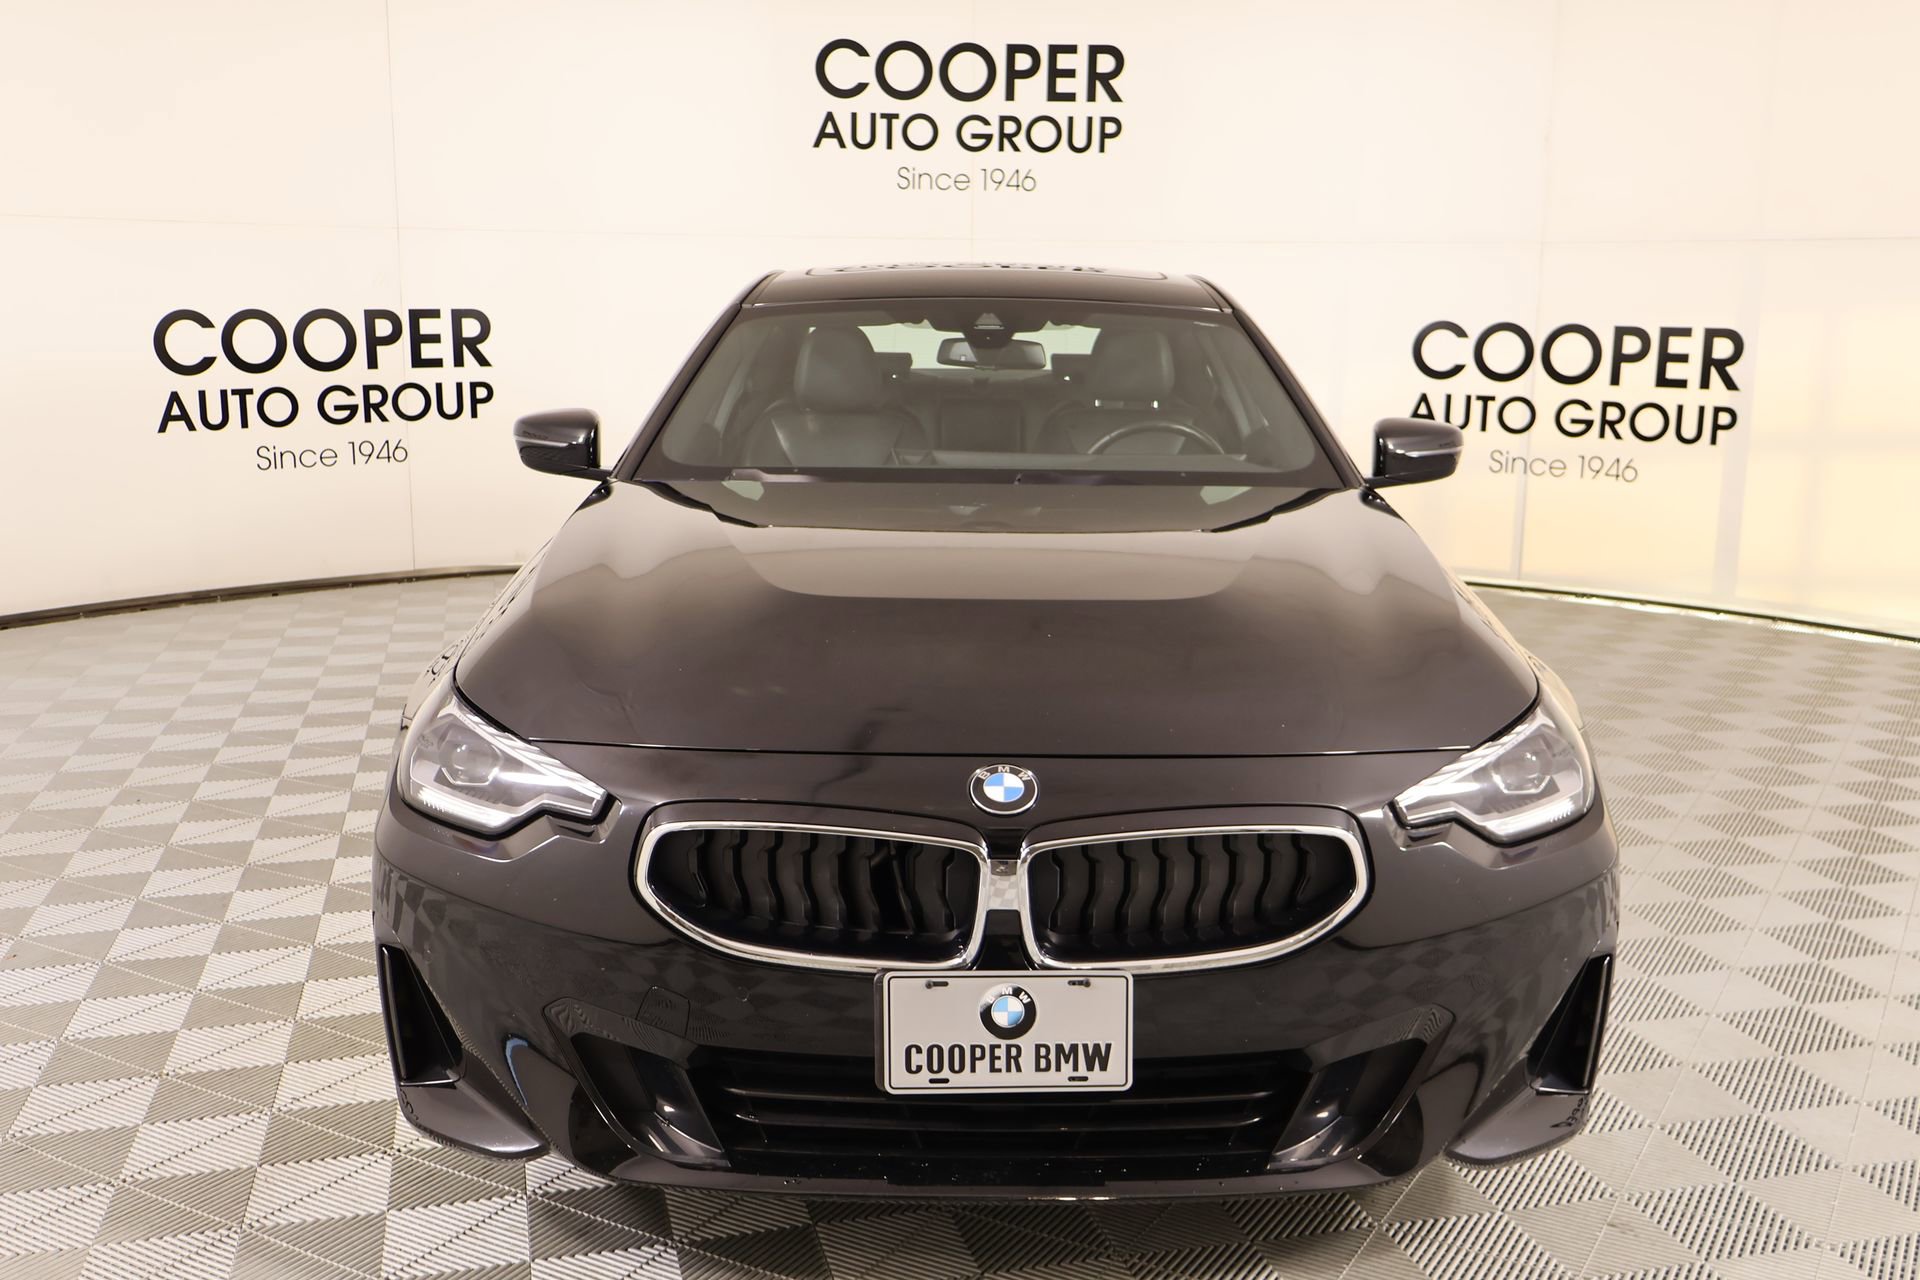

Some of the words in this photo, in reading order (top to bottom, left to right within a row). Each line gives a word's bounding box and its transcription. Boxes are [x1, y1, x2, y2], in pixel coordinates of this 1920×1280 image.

[815, 38, 1125, 102] COOPER
[812, 111, 939, 151] AUTO
[956, 114, 1122, 153] GROUP
[896, 166, 970, 191] Since
[980, 168, 1036, 192] 1946
[153, 308, 492, 376] COOPER
[1412, 320, 1745, 391] COOPER
[157, 386, 299, 433] AUTO
[317, 381, 494, 425] GROUP
[1410, 392, 1536, 434] AUTO
[1555, 399, 1737, 445] GROUP
[256, 445, 338, 471] Since
[347, 438, 408, 465] 1946
[1488, 450, 1567, 478] Since
[1578, 455, 1639, 483] 1946
[978, 766, 1031, 781] BMW
[904, 1043, 1022, 1074] COOPER
[1034, 1042, 1112, 1073] BMW
